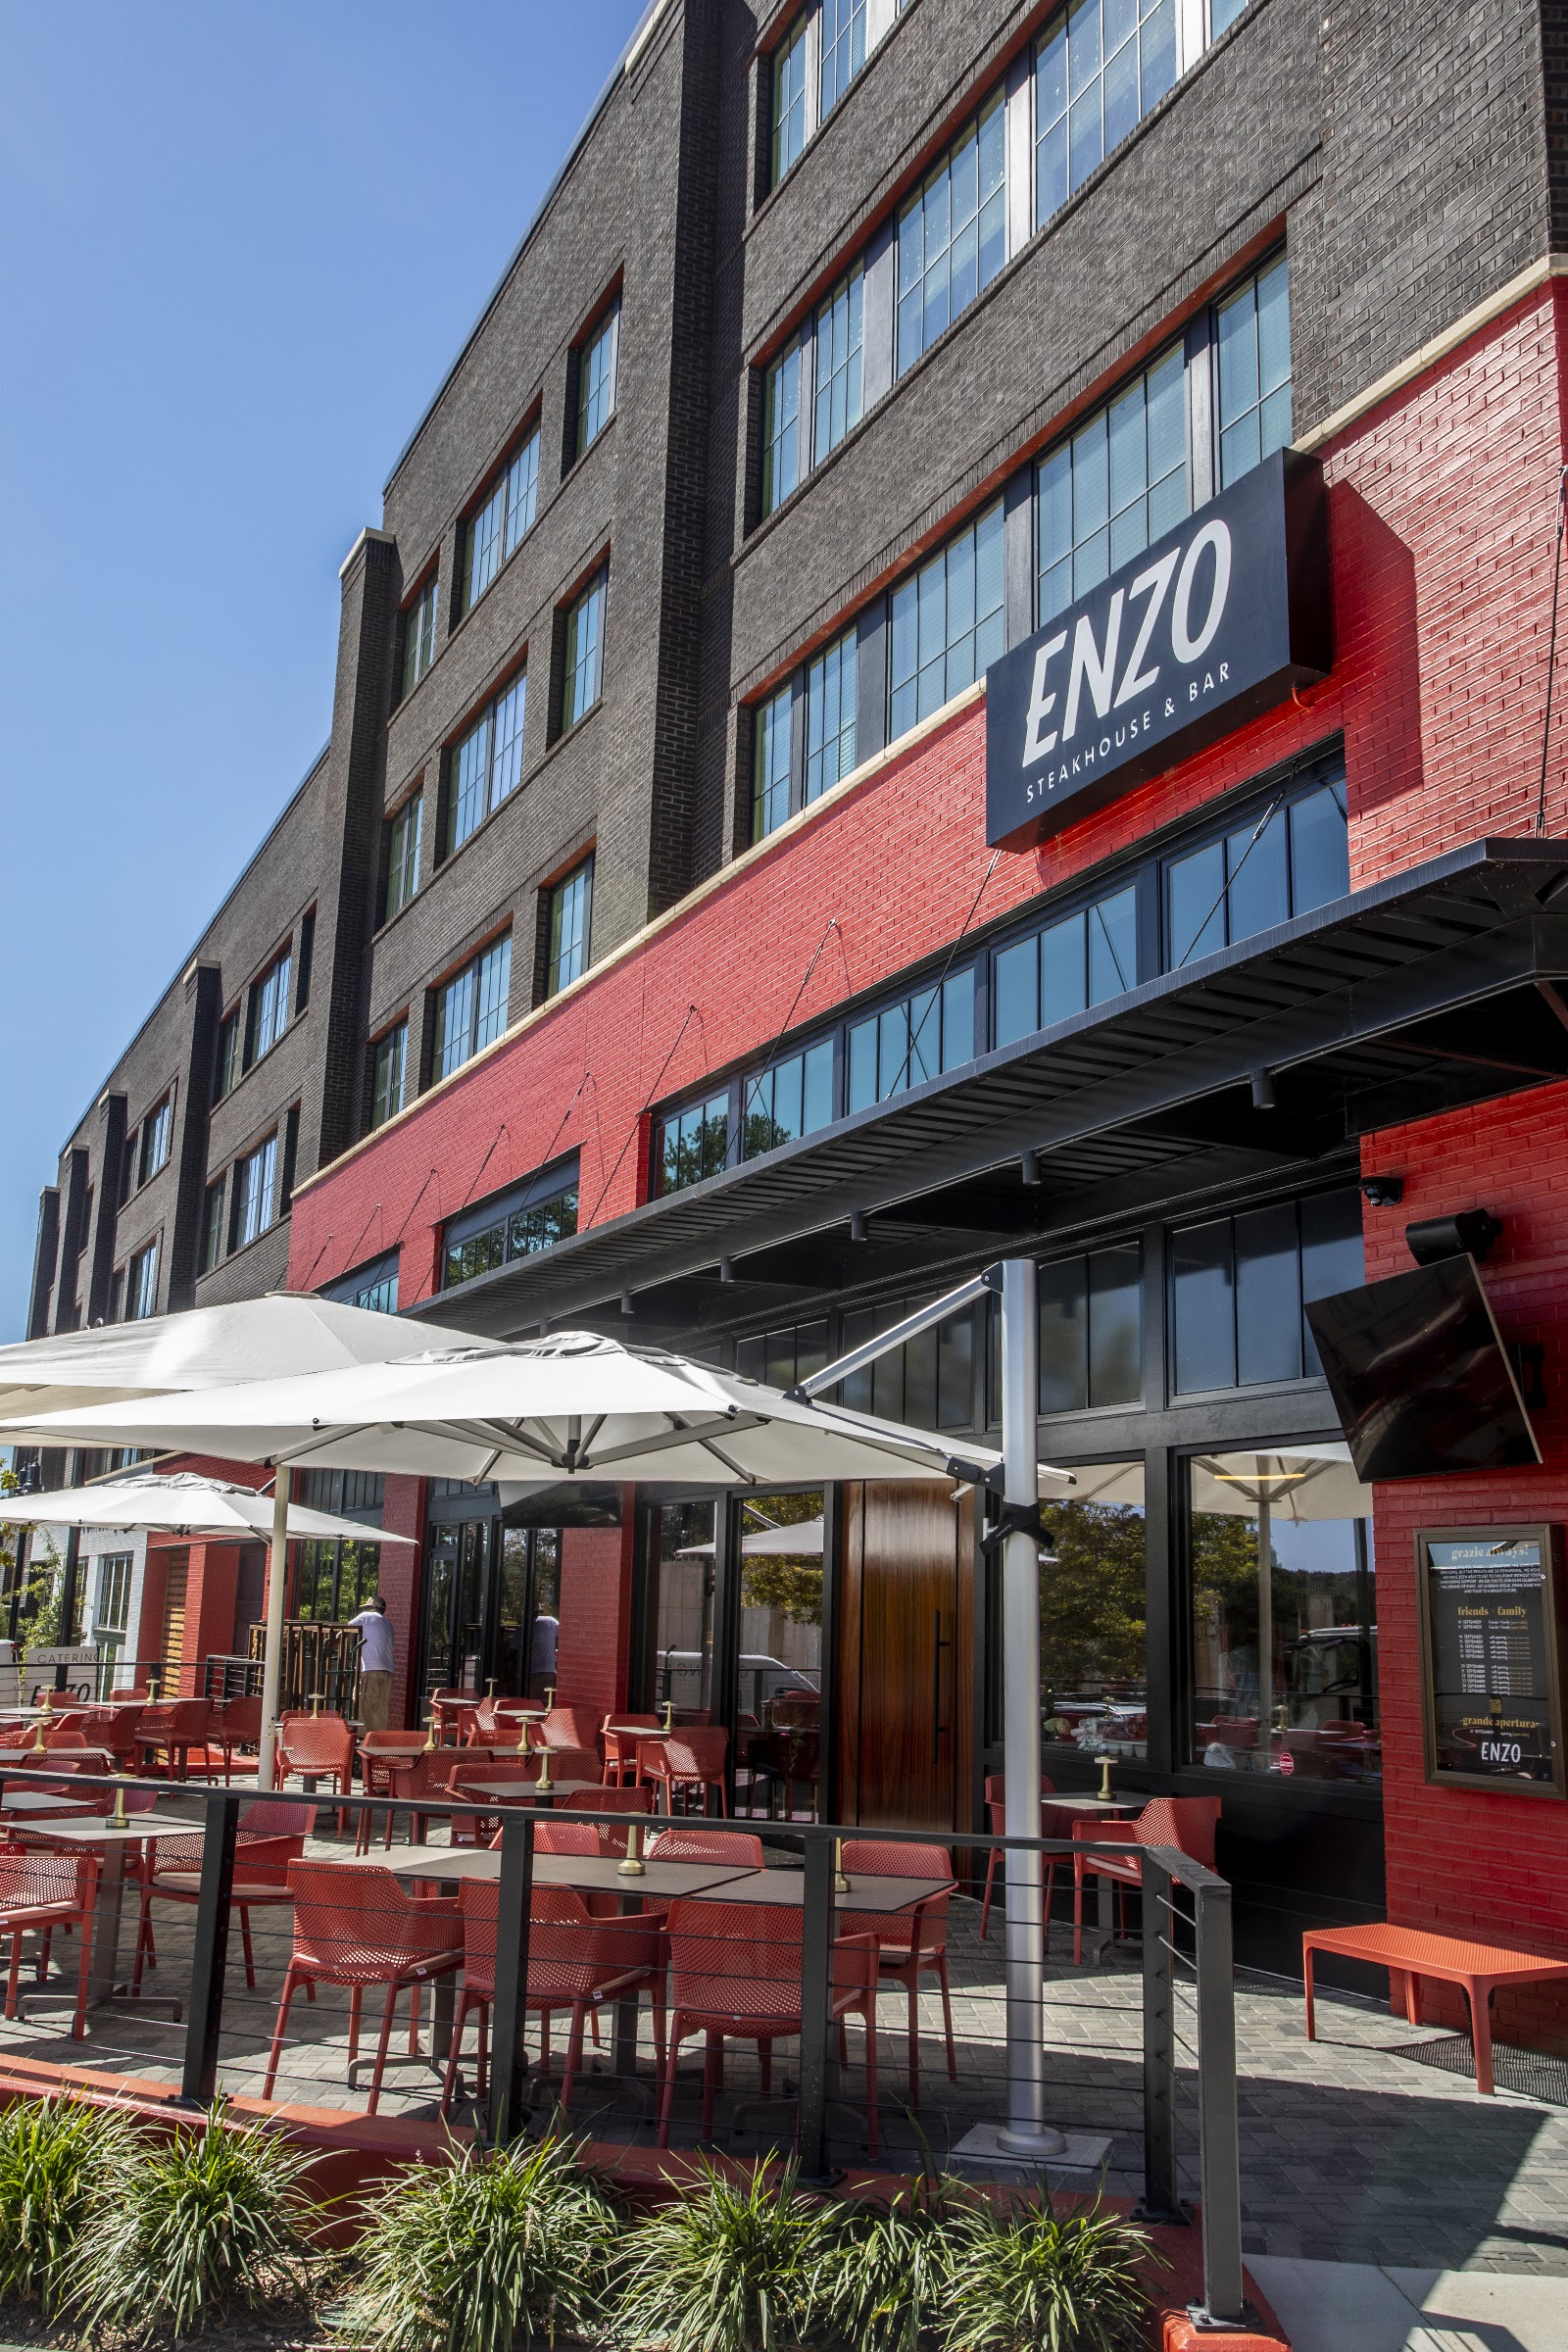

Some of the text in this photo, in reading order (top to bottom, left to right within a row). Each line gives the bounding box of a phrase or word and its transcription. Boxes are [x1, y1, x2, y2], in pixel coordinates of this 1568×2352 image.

[1023, 519, 1231, 767] ENZO
[1027, 662, 1229, 803] STEAKHOUSE & BAR
[1451, 1544, 1529, 1561] grazie always!
[1458, 1606, 1489, 1615] friends
[1497, 1606, 1527, 1618] family
[1482, 1742, 1521, 1763] ENZO
